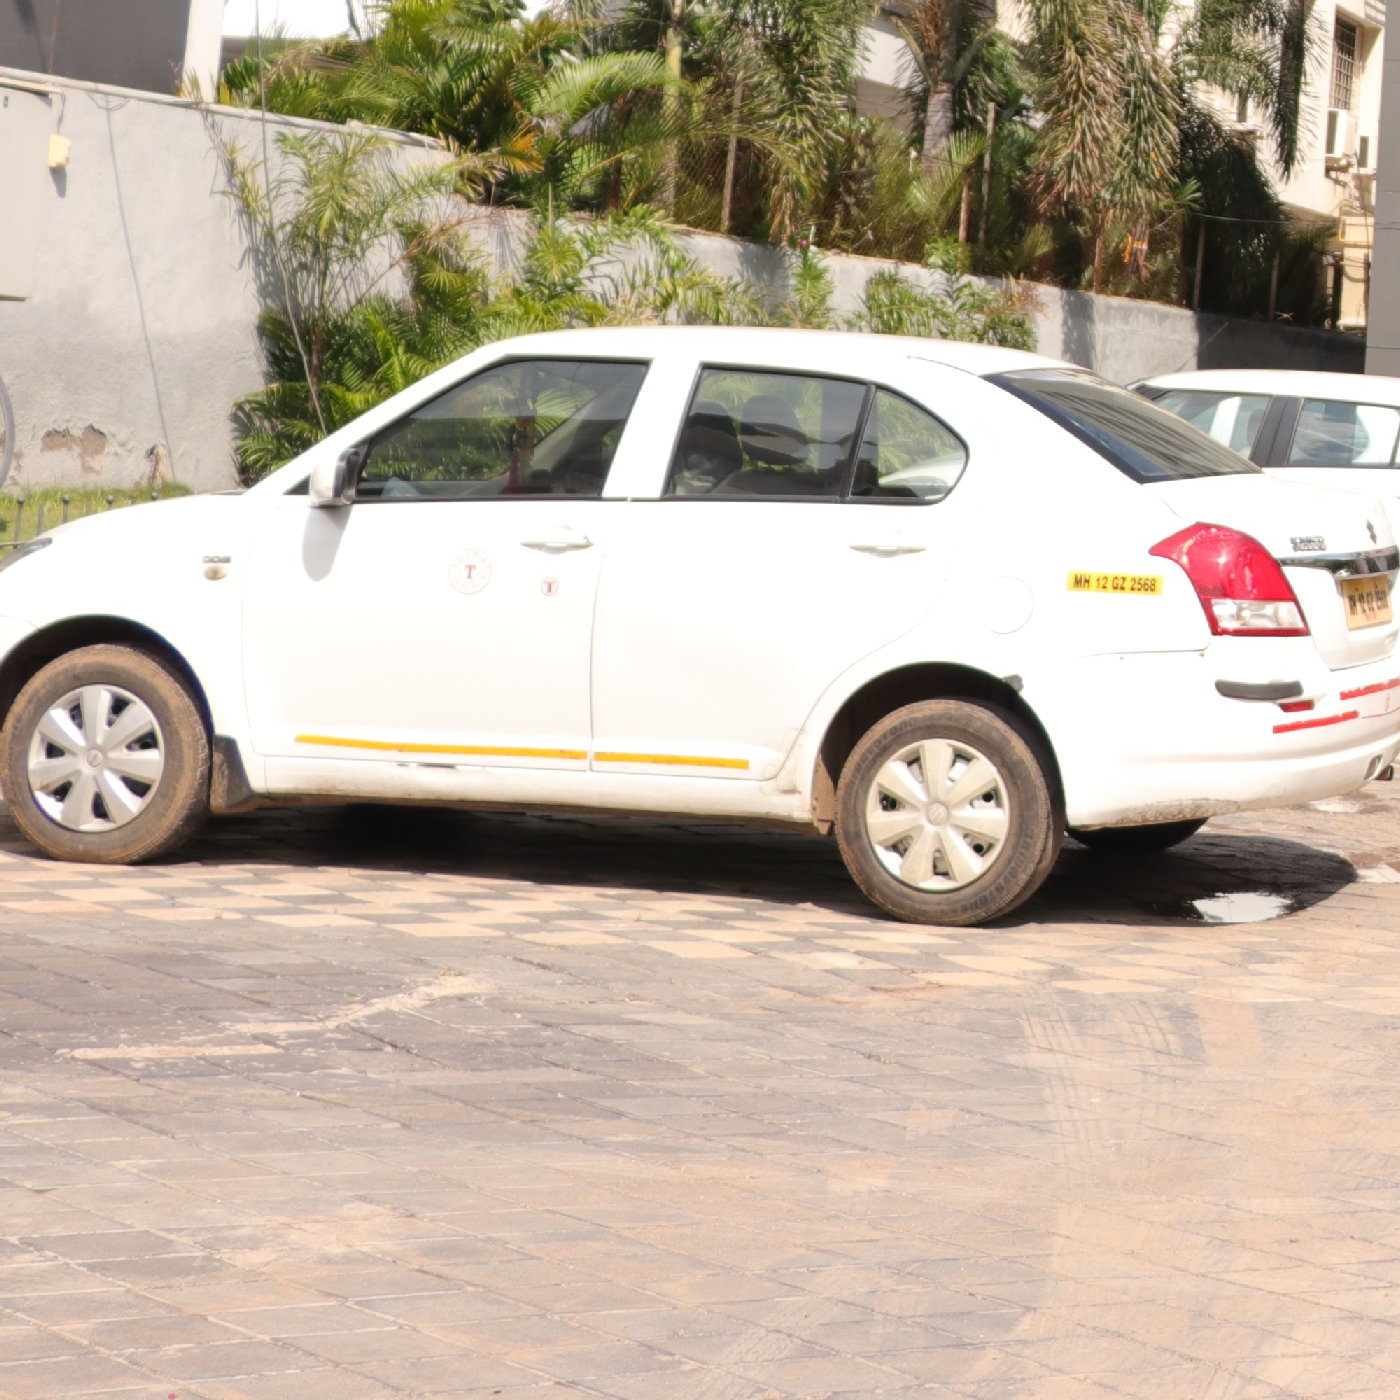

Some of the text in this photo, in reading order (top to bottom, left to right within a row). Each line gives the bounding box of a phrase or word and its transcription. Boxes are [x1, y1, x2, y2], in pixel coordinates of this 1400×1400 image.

[1073, 573, 1156, 592] MH 12 GZ 2568
